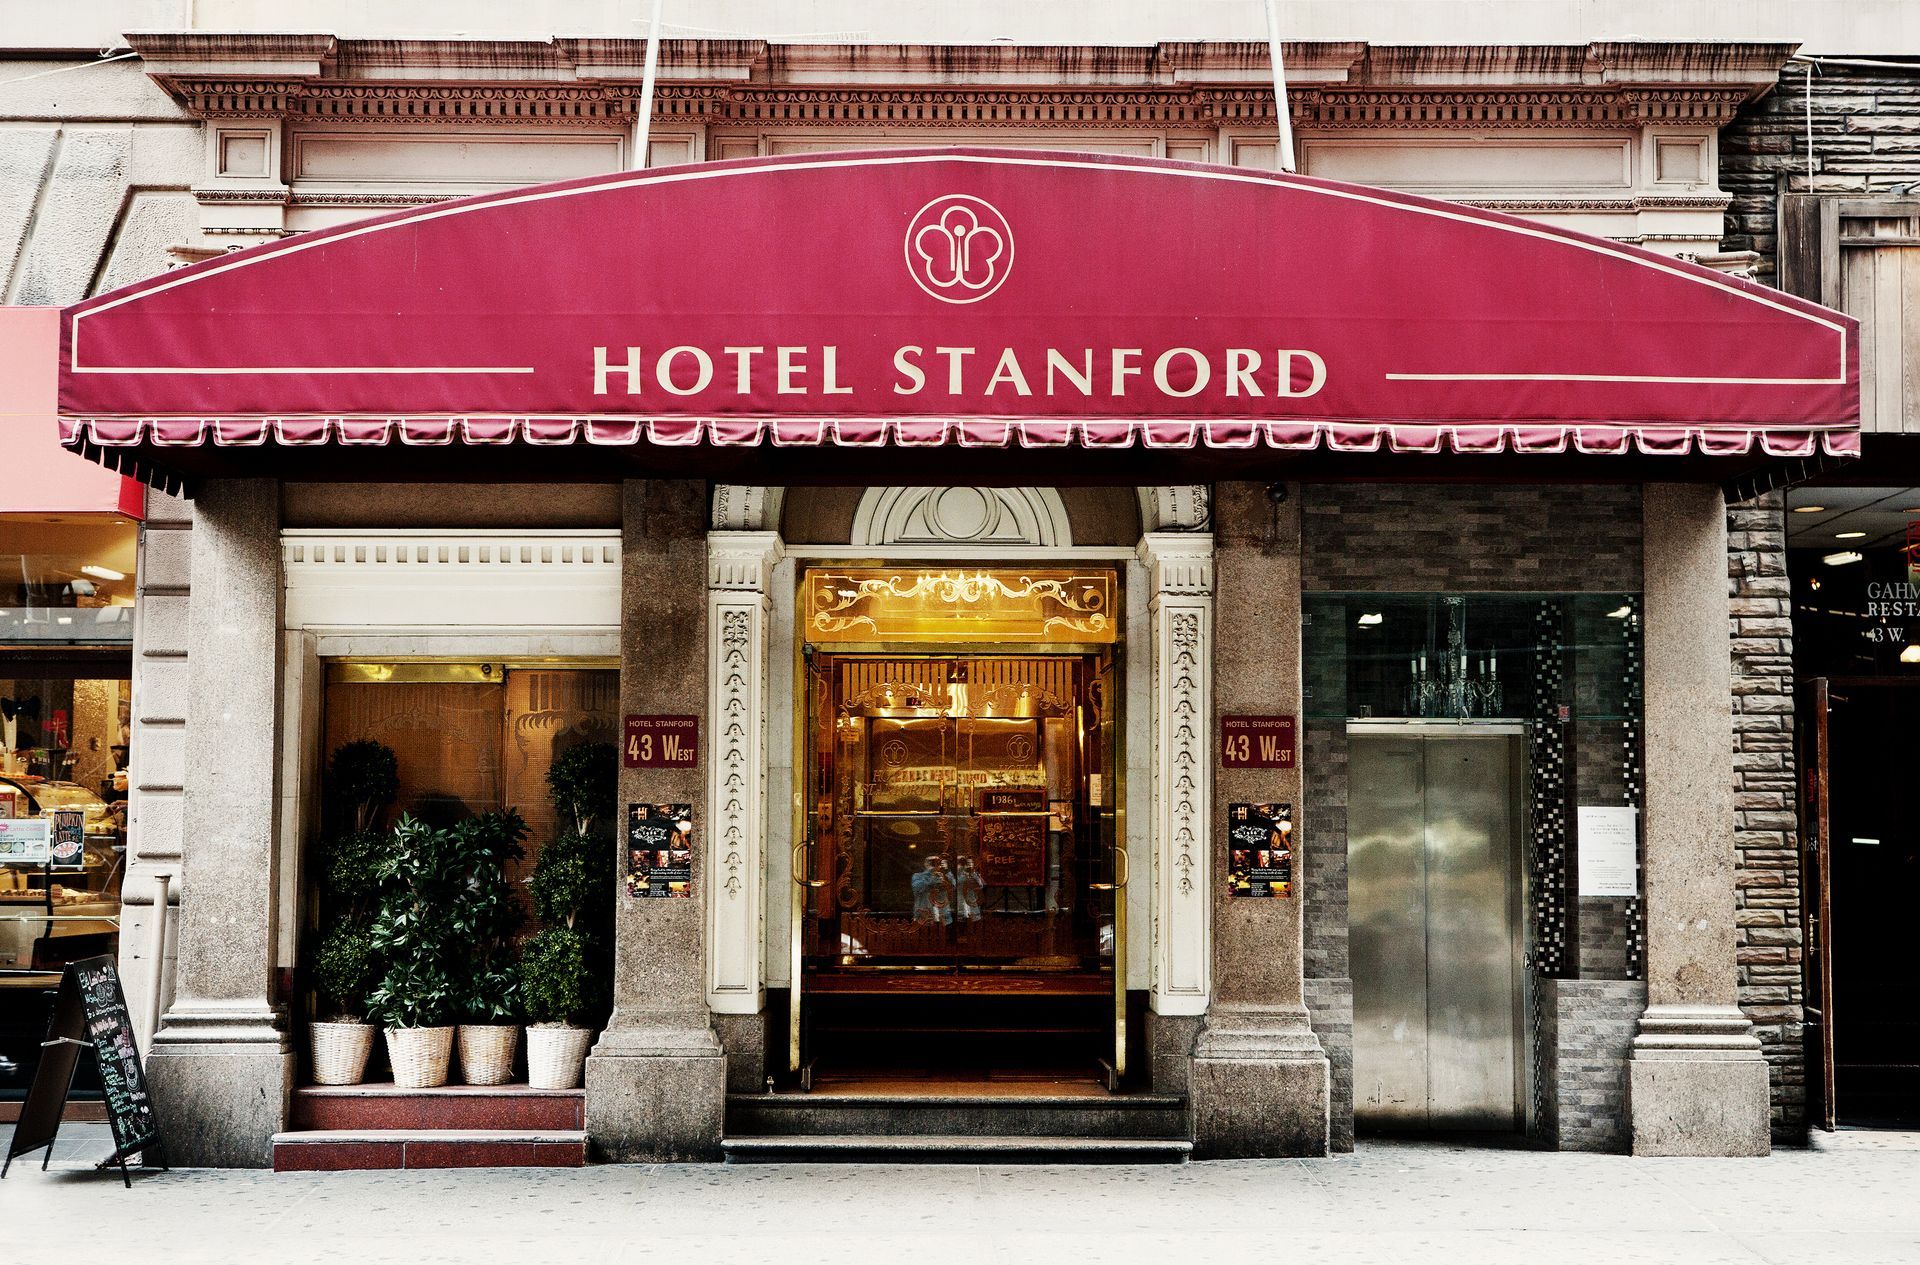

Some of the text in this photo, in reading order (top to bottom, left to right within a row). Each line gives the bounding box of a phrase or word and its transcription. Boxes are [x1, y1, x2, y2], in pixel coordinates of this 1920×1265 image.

[593, 345, 1327, 398] HOTEL STANFORD
[655, 720, 694, 728] STANFORD
[628, 734, 653, 761] 43
[1225, 735, 1250, 761] 43
[55, 813, 84, 829] PUMPKIN
[54, 831, 71, 843] LATTE
[986, 855, 1015, 865] FREE
